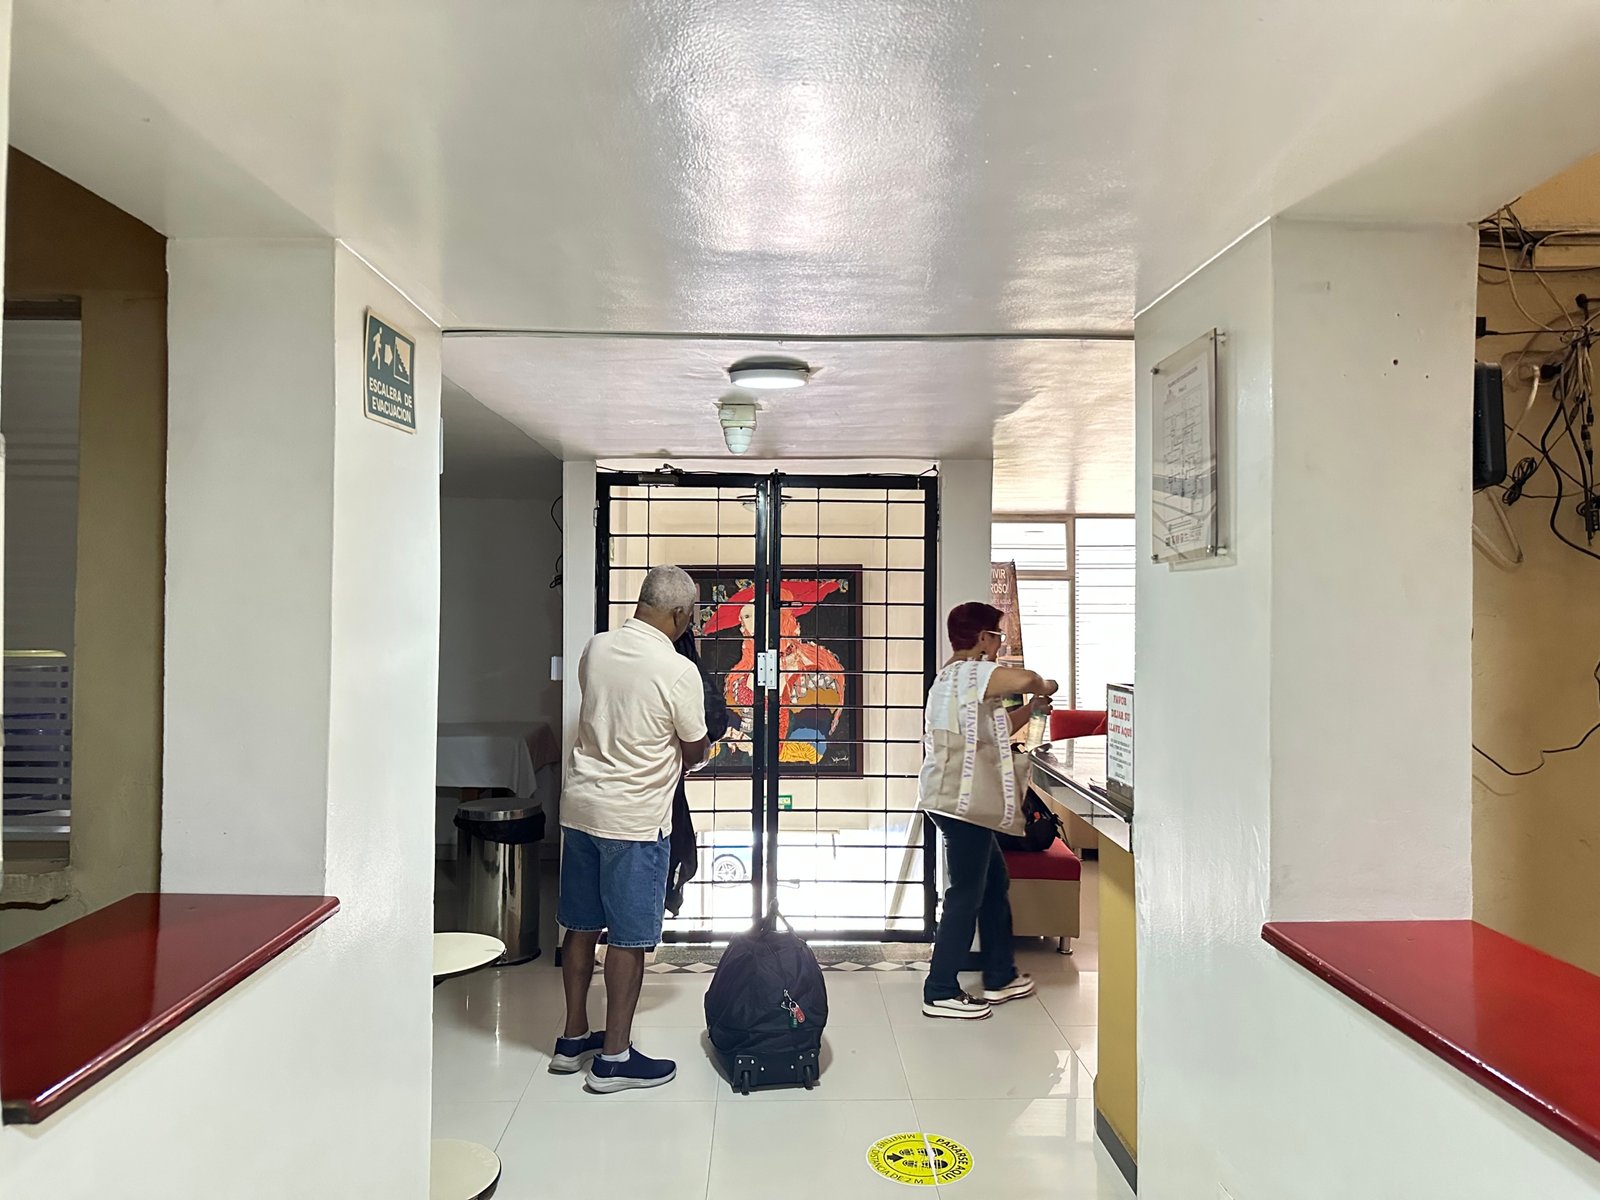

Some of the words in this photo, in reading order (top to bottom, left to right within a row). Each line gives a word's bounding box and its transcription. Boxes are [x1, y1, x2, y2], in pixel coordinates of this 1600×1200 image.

[369, 377, 402, 403] ESCALERA
[404, 393, 413, 408] DE
[371, 396, 412, 423] EVACUACION
[966, 700, 977, 745] BONITA
[963, 750, 975, 778] VIDA
[995, 715, 1010, 759] BONITA
[1004, 771, 1014, 798] VIDA
[935, 1138, 969, 1165] PARARSE
[941, 1165, 967, 1181] AQUI
